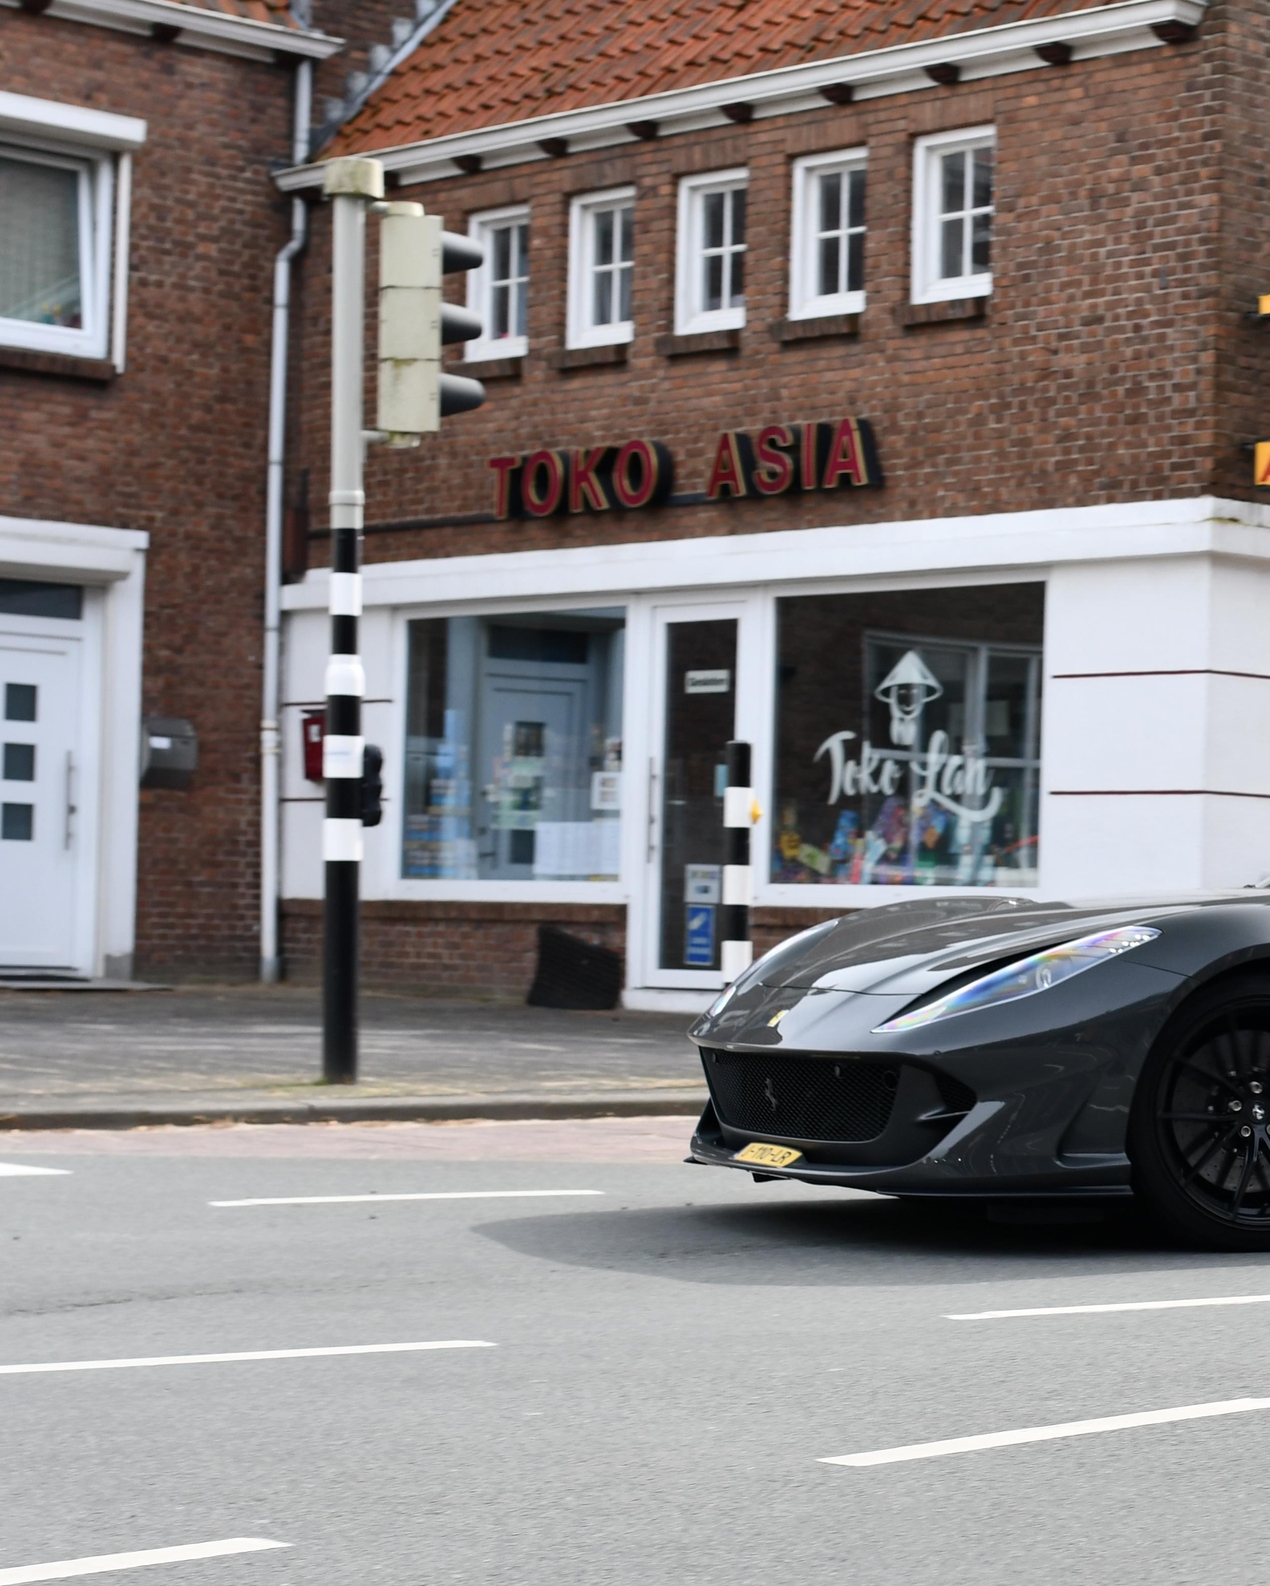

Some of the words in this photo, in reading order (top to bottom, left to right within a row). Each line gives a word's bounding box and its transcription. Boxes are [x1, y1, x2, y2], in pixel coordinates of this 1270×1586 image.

[487, 439, 660, 520] TOKO
[706, 416, 869, 499] ASIA
[813, 730, 903, 805] Toko
